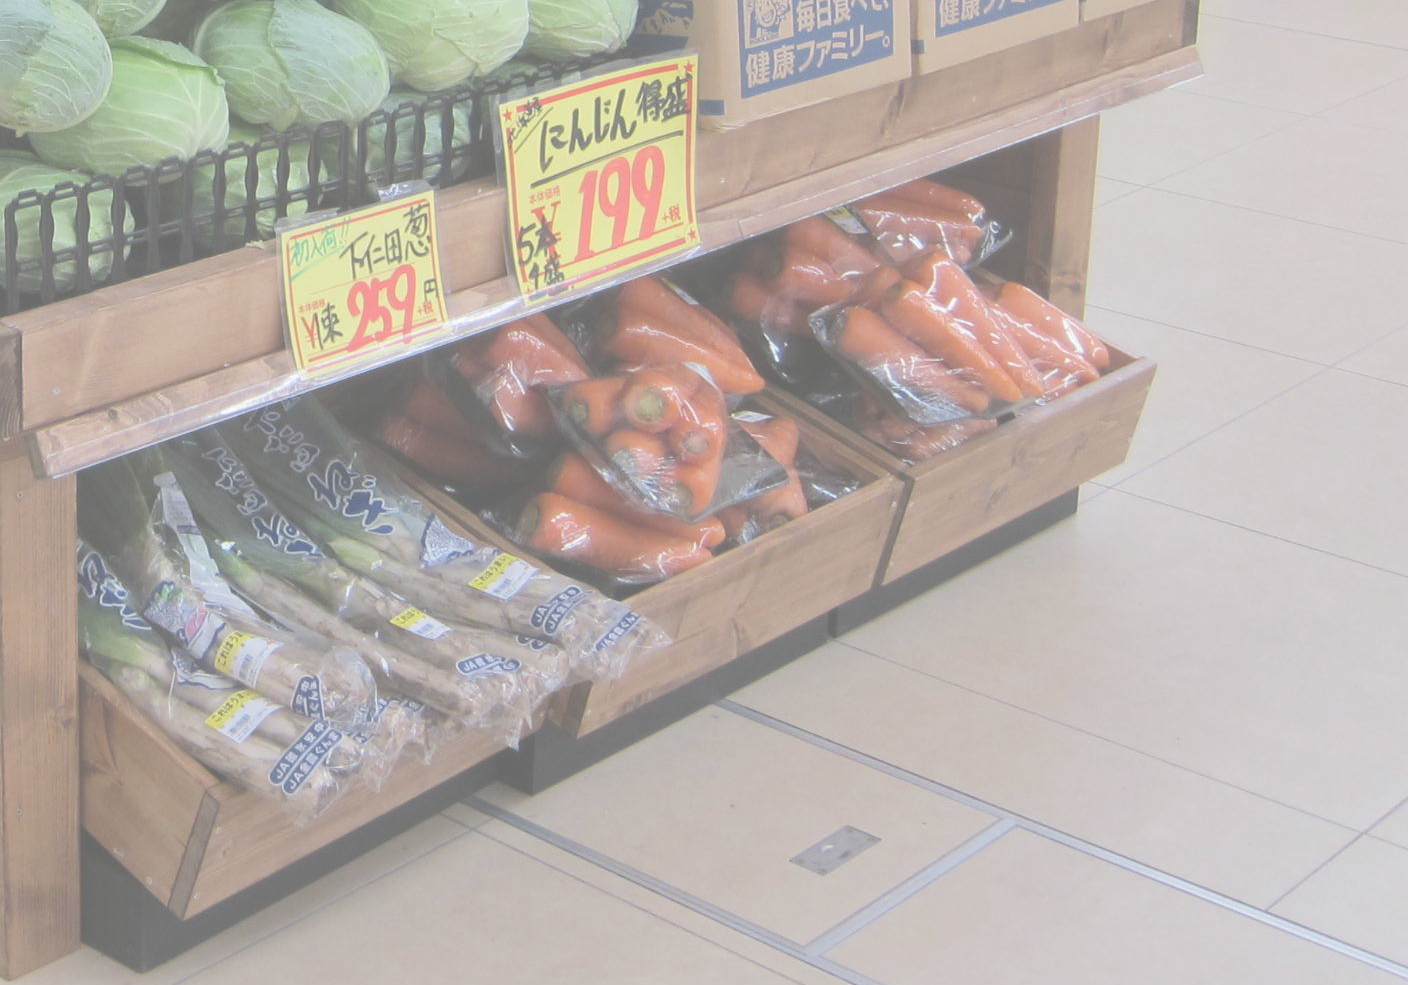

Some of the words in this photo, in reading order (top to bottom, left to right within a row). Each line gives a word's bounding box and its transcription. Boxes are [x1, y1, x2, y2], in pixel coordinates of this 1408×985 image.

[745, 24, 891, 89] 健康ファミリー。
[539, 88, 638, 174] にんじん
[574, 144, 666, 263] 199
[661, 205, 683, 226] +税
[518, 222, 558, 266] 5本
[346, 263, 417, 353] 259
[417, 300, 434, 315] +税
[423, 278, 438, 303] 円
